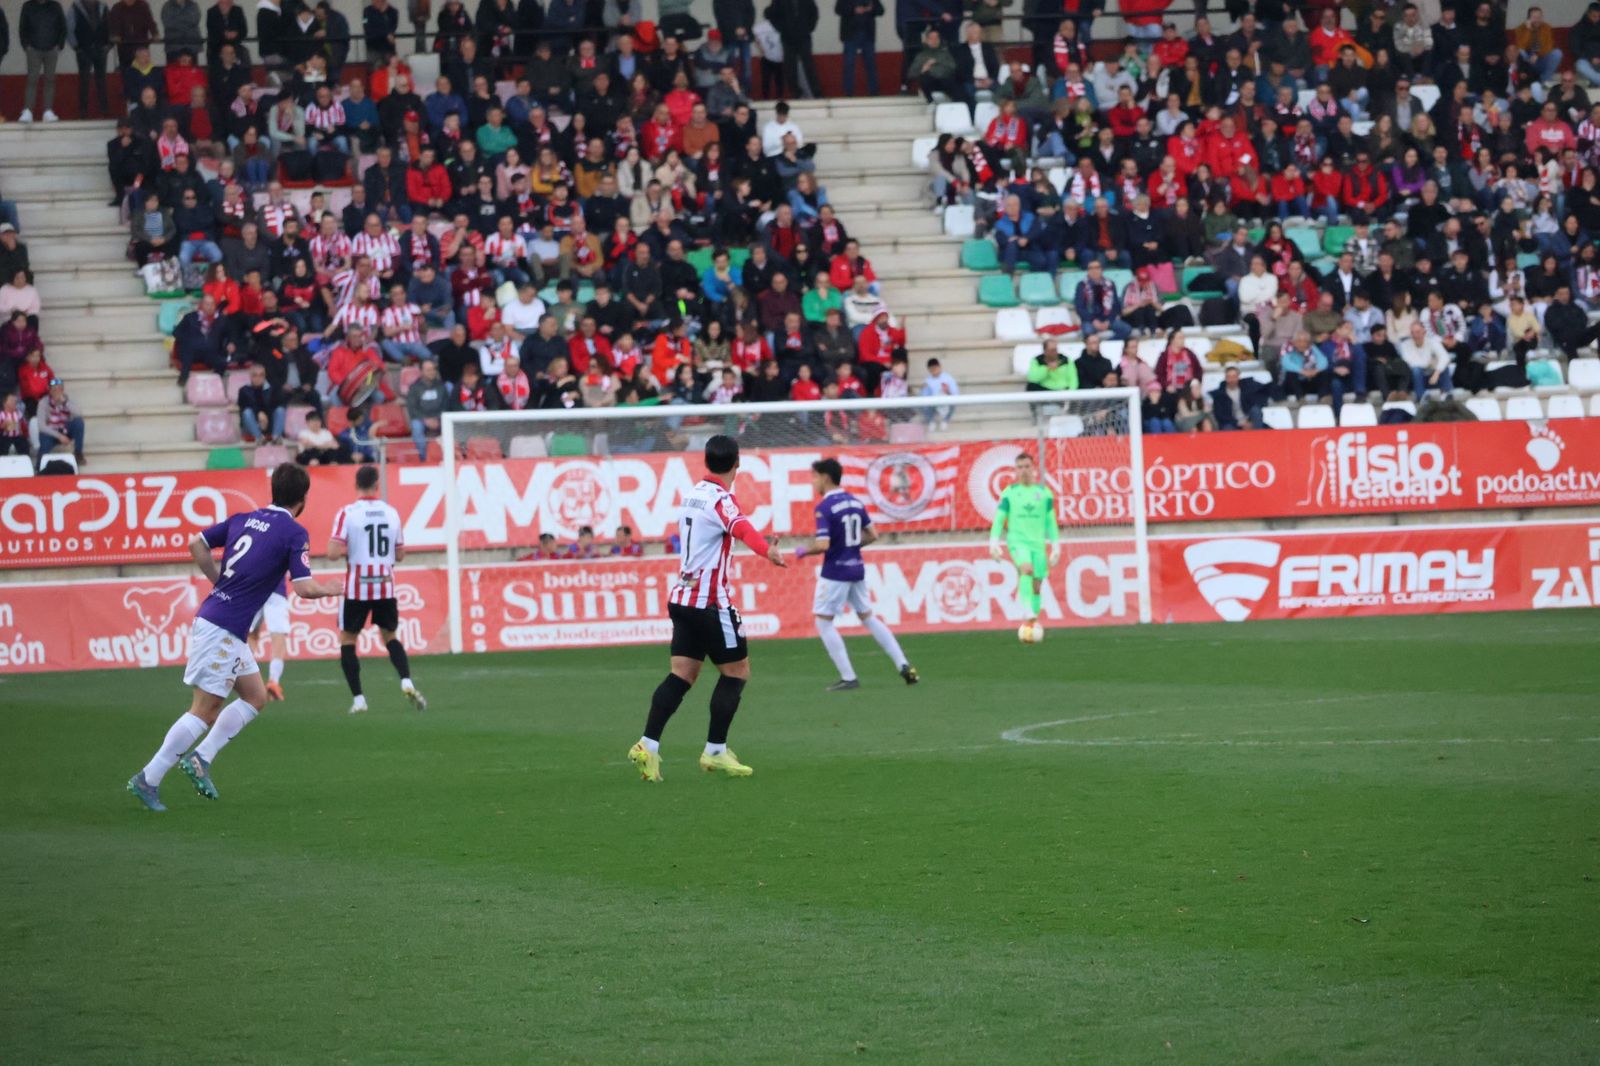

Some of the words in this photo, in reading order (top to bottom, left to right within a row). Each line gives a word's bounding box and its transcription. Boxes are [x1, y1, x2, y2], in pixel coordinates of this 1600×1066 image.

[1337, 431, 1444, 480] fisio
[992, 466, 1133, 502] CNTRO
[1145, 457, 1276, 492] ÓPTICO
[244, 518, 271, 532] LUCAS
[364, 523, 389, 558] 16
[685, 517, 692, 567] 7
[841, 513, 862, 547] 10
[0, 536, 94, 554] UTIDOS
[103, 537, 113, 548] Y
[223, 534, 253, 578] 2
[543, 569, 640, 590] bodegas
[1278, 548, 1495, 598] FRIMAY
[1531, 566, 1600, 609] ZA
[231, 657, 240, 675] 2
